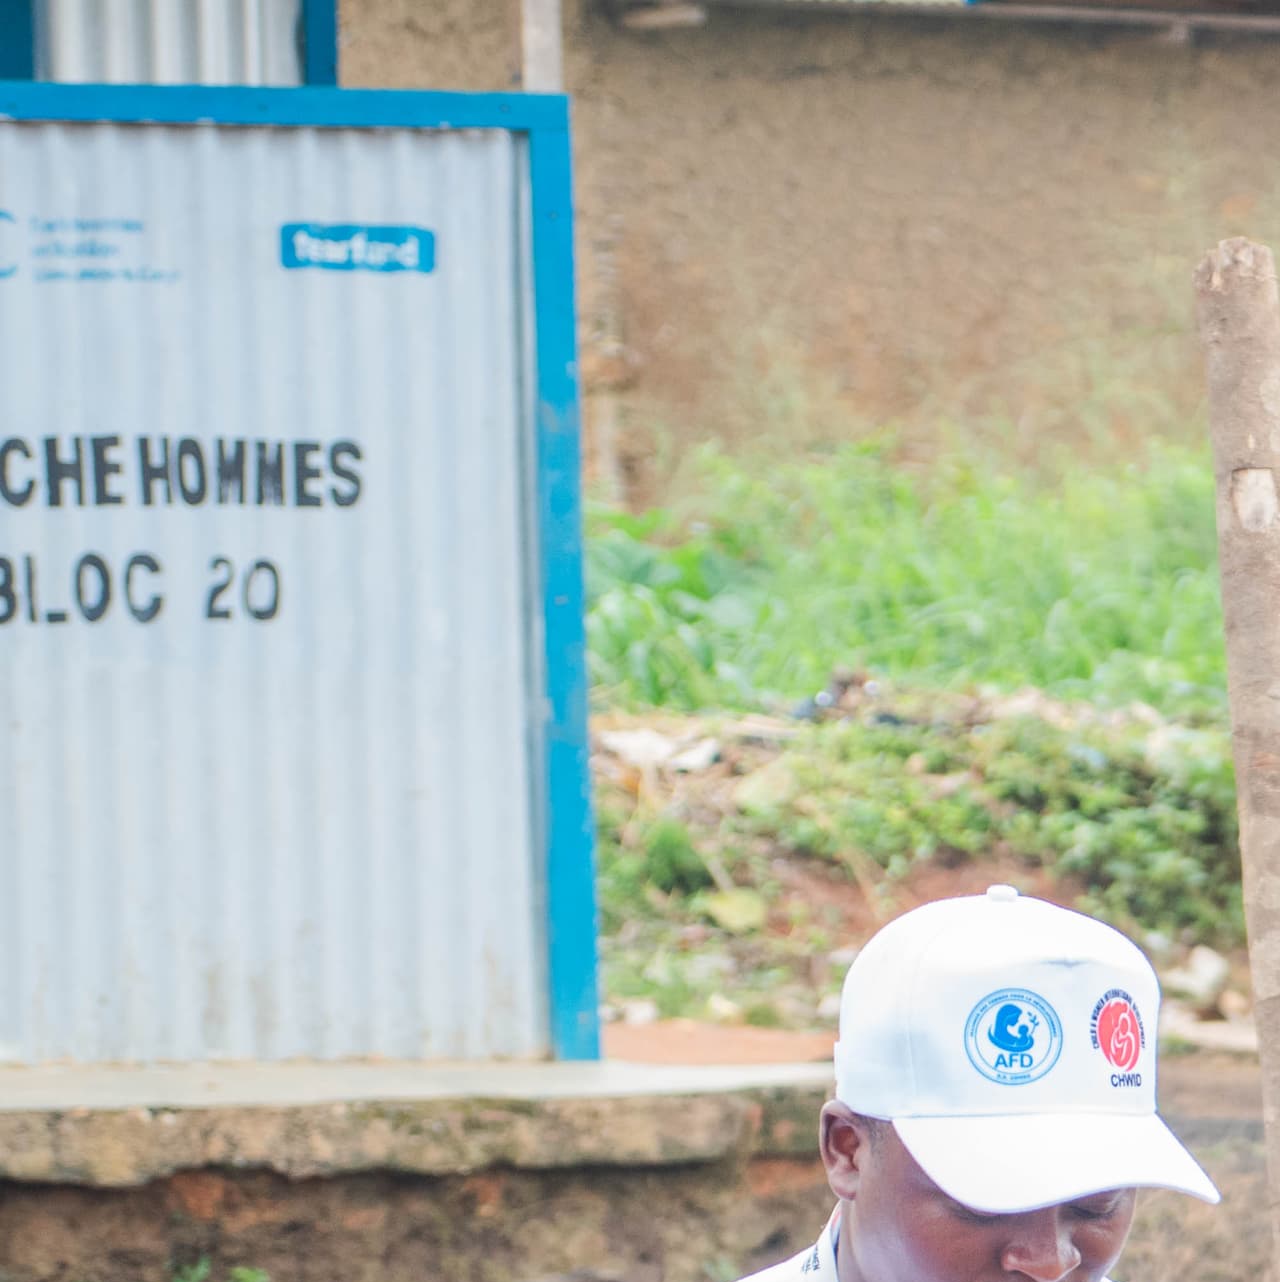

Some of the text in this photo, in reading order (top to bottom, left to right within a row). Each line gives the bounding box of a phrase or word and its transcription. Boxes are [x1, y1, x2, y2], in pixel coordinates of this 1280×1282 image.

[293, 229, 419, 267] tearfund
[138, 436, 364, 508] HOMMES
[206, 555, 281, 621] 20
[994, 1053, 1034, 1068] AFD
[1110, 1074, 1142, 1088] CHWID
